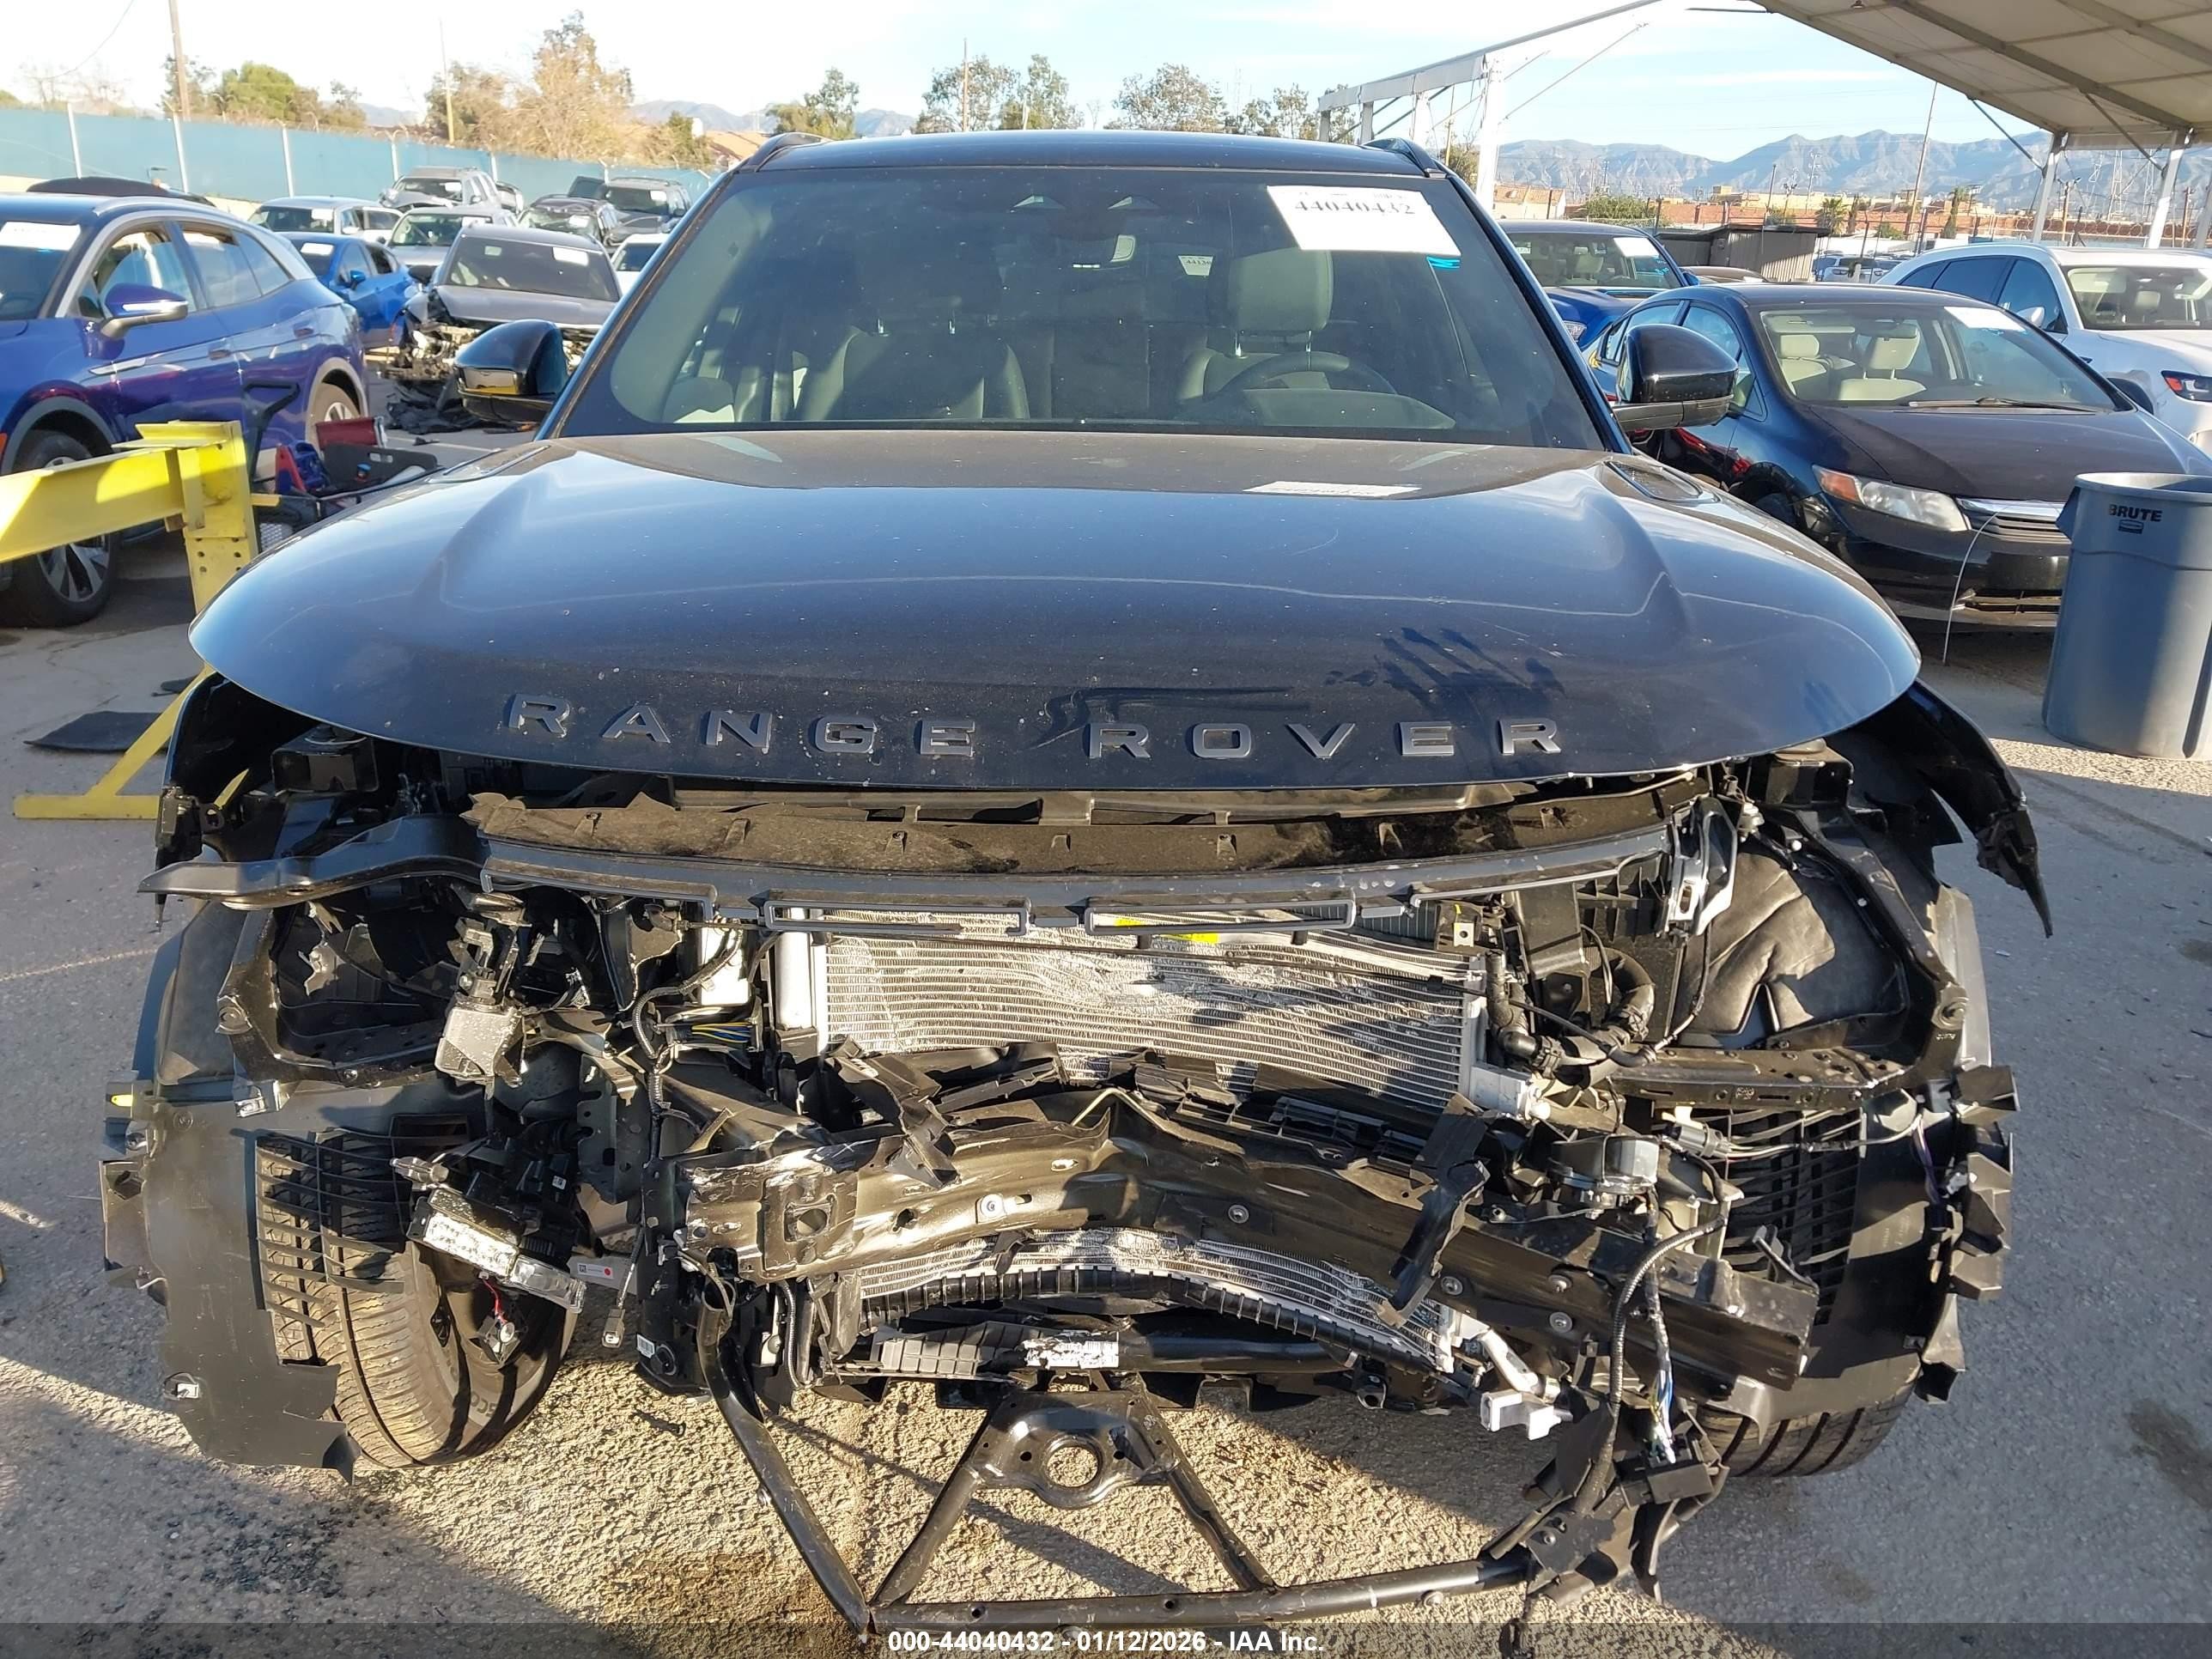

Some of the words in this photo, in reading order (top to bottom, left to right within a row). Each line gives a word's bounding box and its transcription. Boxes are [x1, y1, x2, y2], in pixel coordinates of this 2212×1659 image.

[1295, 200, 1416, 215] 44040432
[2108, 503, 2163, 523] BRUTE
[508, 693, 975, 756] RANGE
[1087, 717, 1562, 760] ROVER
